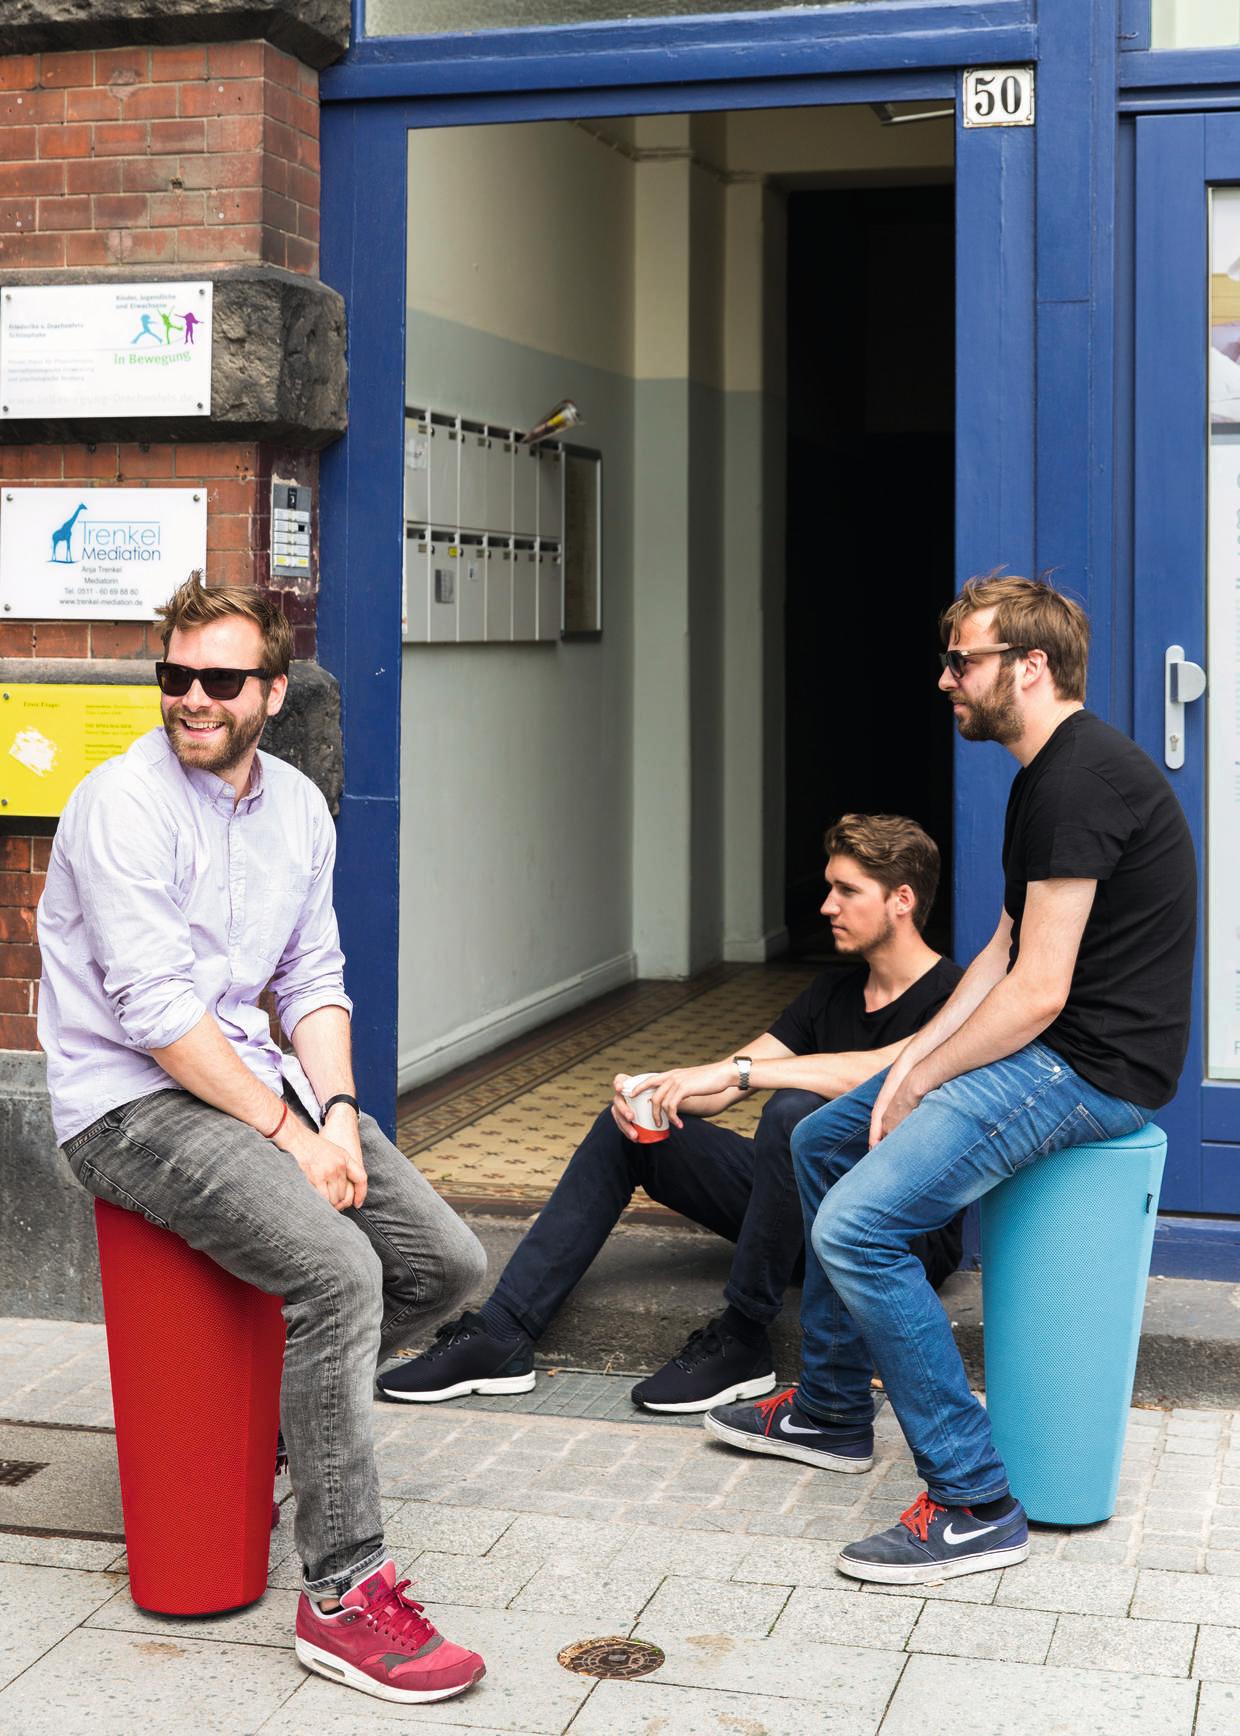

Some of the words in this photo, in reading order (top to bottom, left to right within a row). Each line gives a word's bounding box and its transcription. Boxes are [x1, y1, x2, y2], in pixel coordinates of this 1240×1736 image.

[974, 75, 1022, 117] 50
[128, 350, 192, 366] Bewegung
[78, 520, 161, 545] Trenkel
[81, 545, 161, 561] Mediation
[81, 565, 97, 574] Anja
[98, 565, 122, 573] Trenkel
[83, 577, 119, 585] Mediatorin
[77, 587, 93, 595] 0511
[59, 599, 143, 607] www.trenkel-mediation.de
